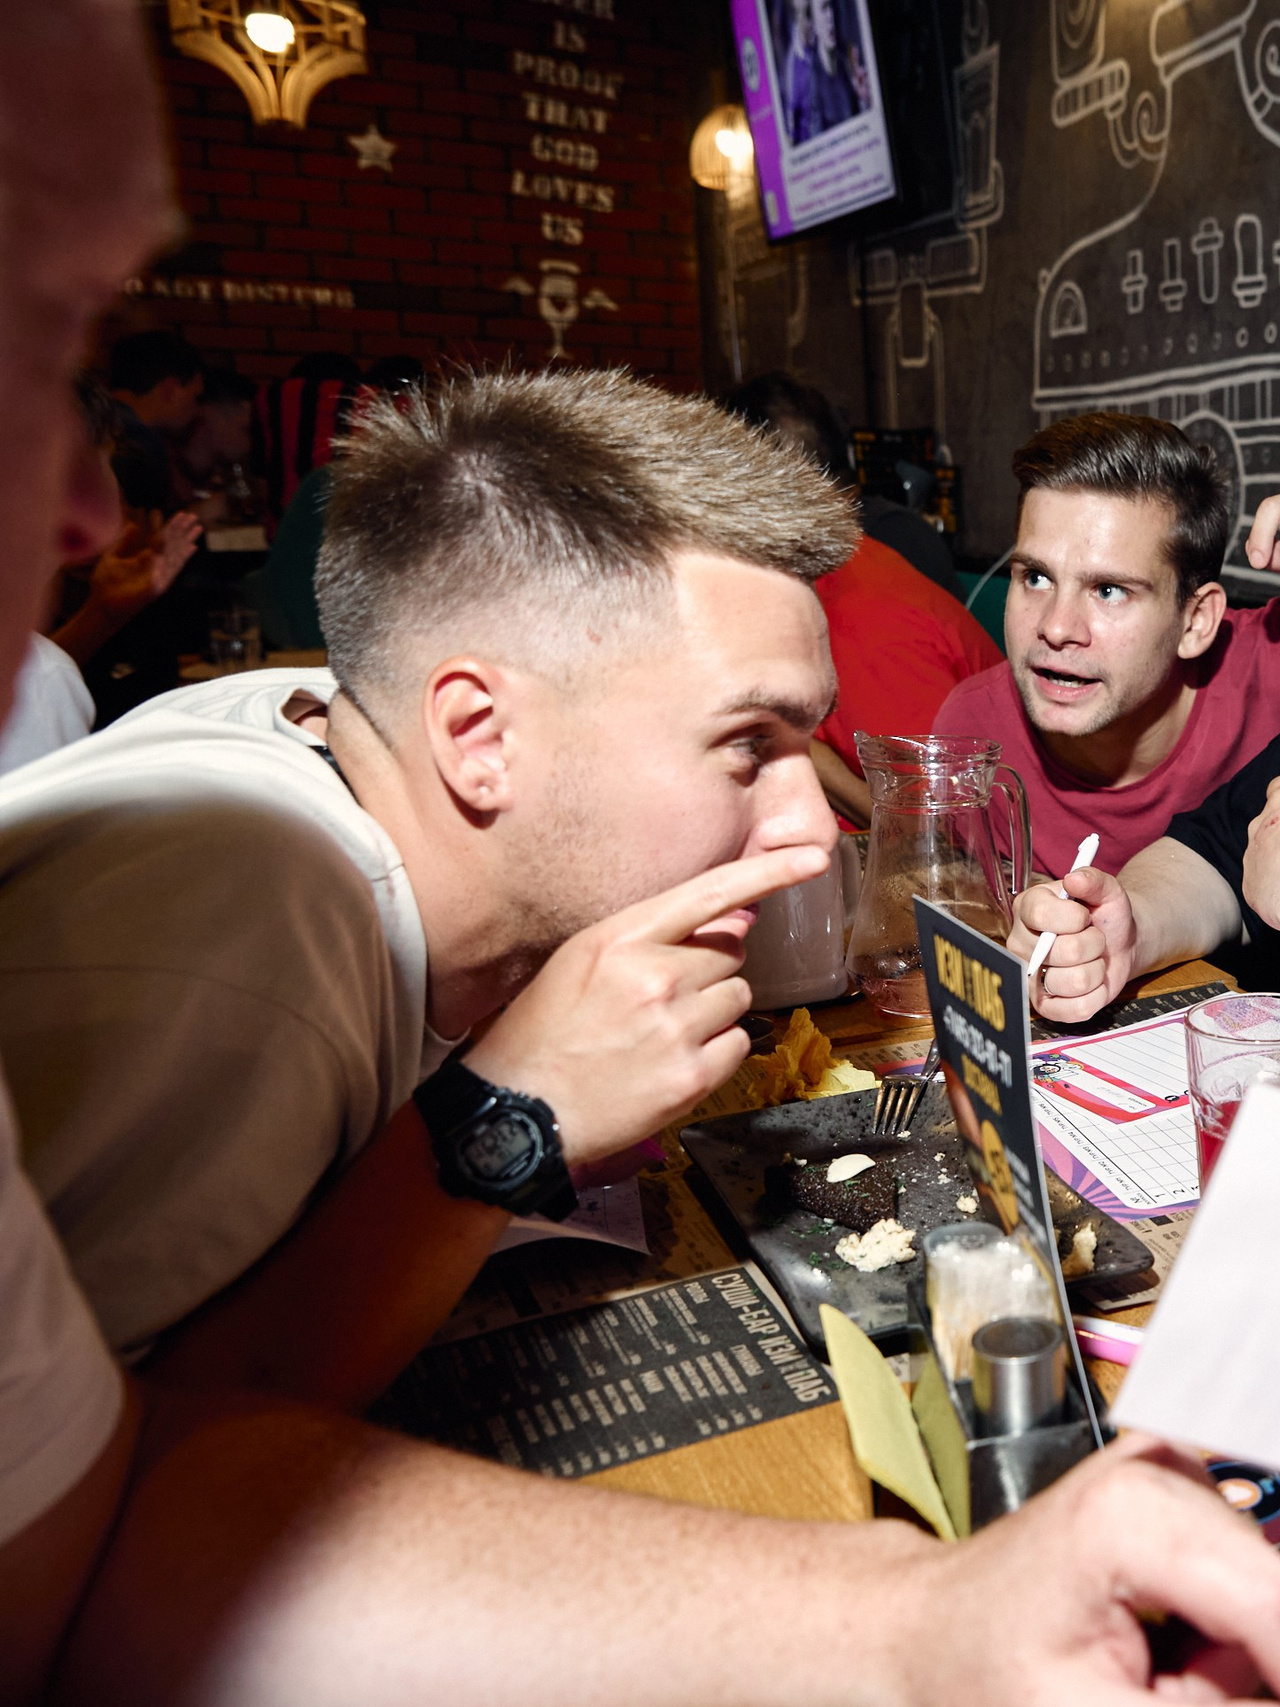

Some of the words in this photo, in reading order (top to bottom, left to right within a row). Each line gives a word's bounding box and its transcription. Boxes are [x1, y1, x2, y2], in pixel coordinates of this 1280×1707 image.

[553, 19, 586, 52] IS
[513, 51, 624, 100] PROOF
[522, 91, 610, 134] THAT
[531, 133, 599, 172] GOD
[511, 170, 615, 213] LOVES
[541, 212, 584, 246] US
[711, 1273, 780, 1334] СУШИ-БАР
[783, 1368, 831, 1402] ПАБ
